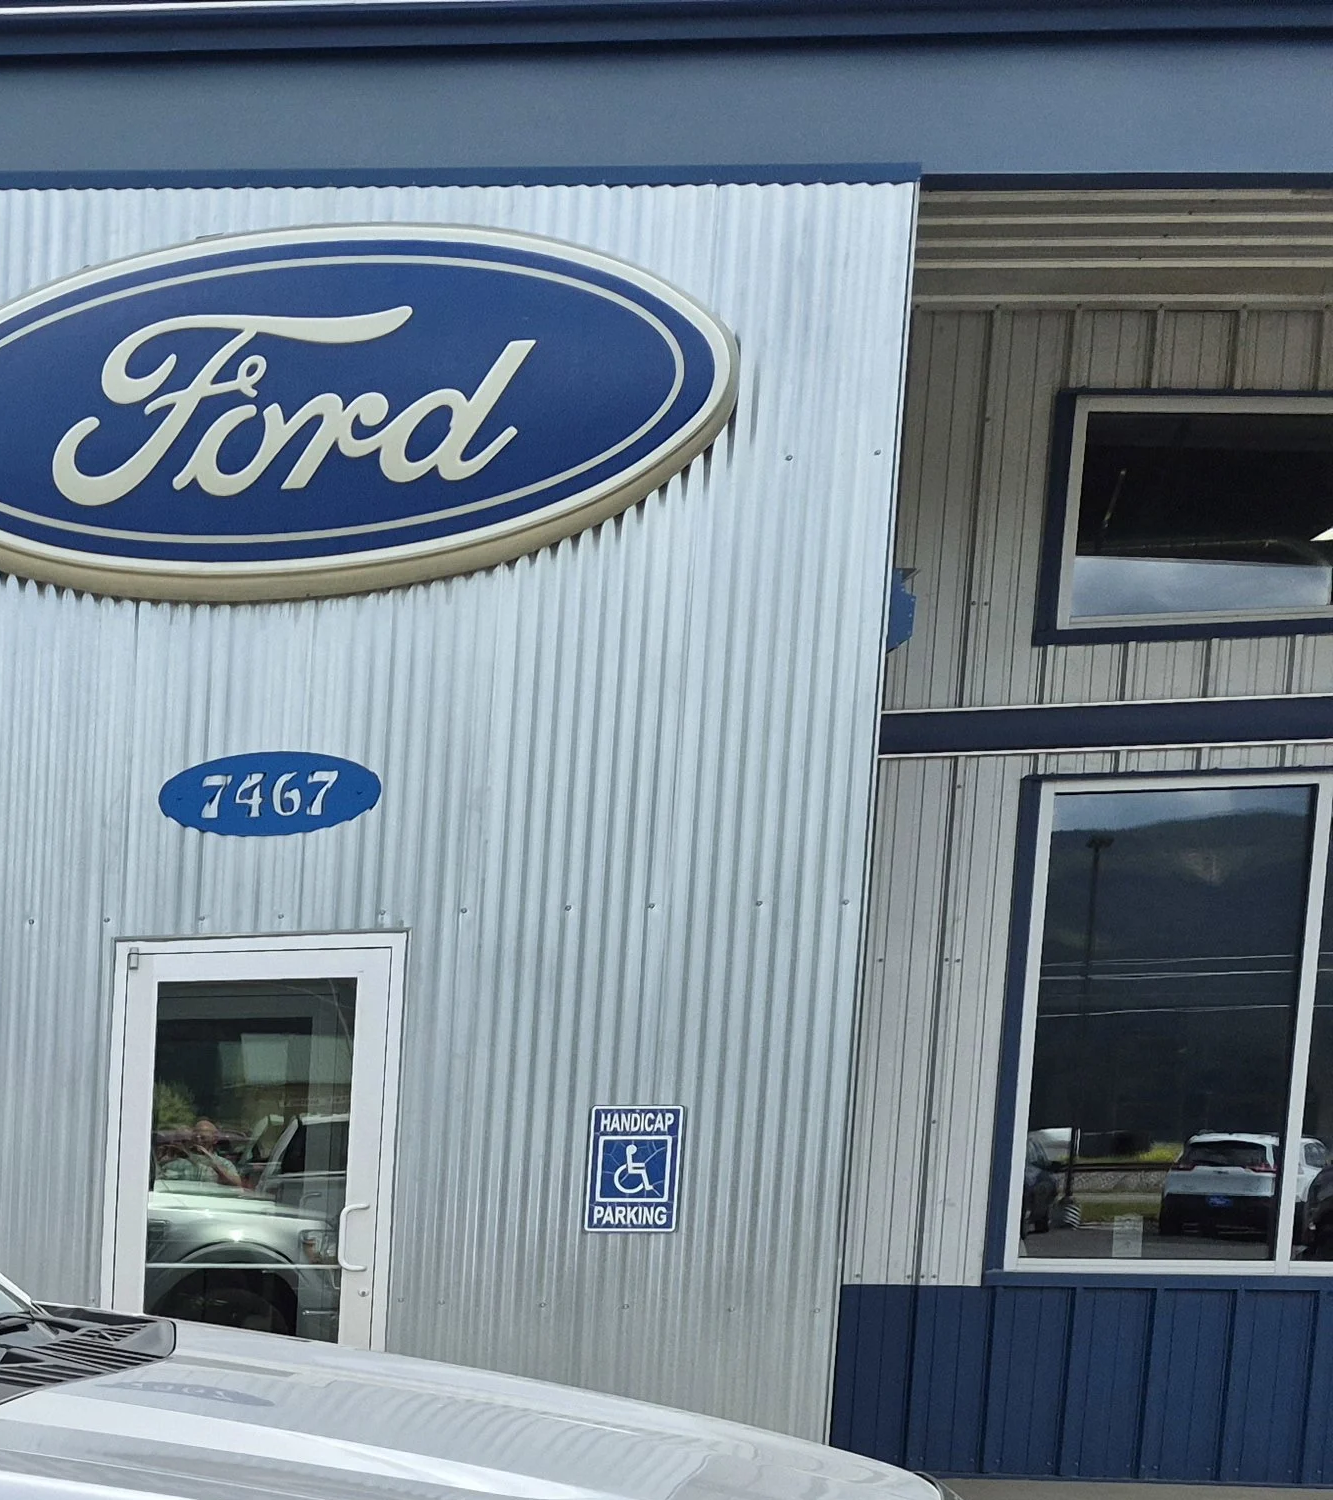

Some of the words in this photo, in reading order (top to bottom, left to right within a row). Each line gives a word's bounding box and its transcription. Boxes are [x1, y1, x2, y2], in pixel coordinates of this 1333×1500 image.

[52, 305, 536, 506] Ford
[200, 770, 339, 819] 7467
[600, 1112, 675, 1132] HANDICAP
[593, 1205, 668, 1226] PARKING
